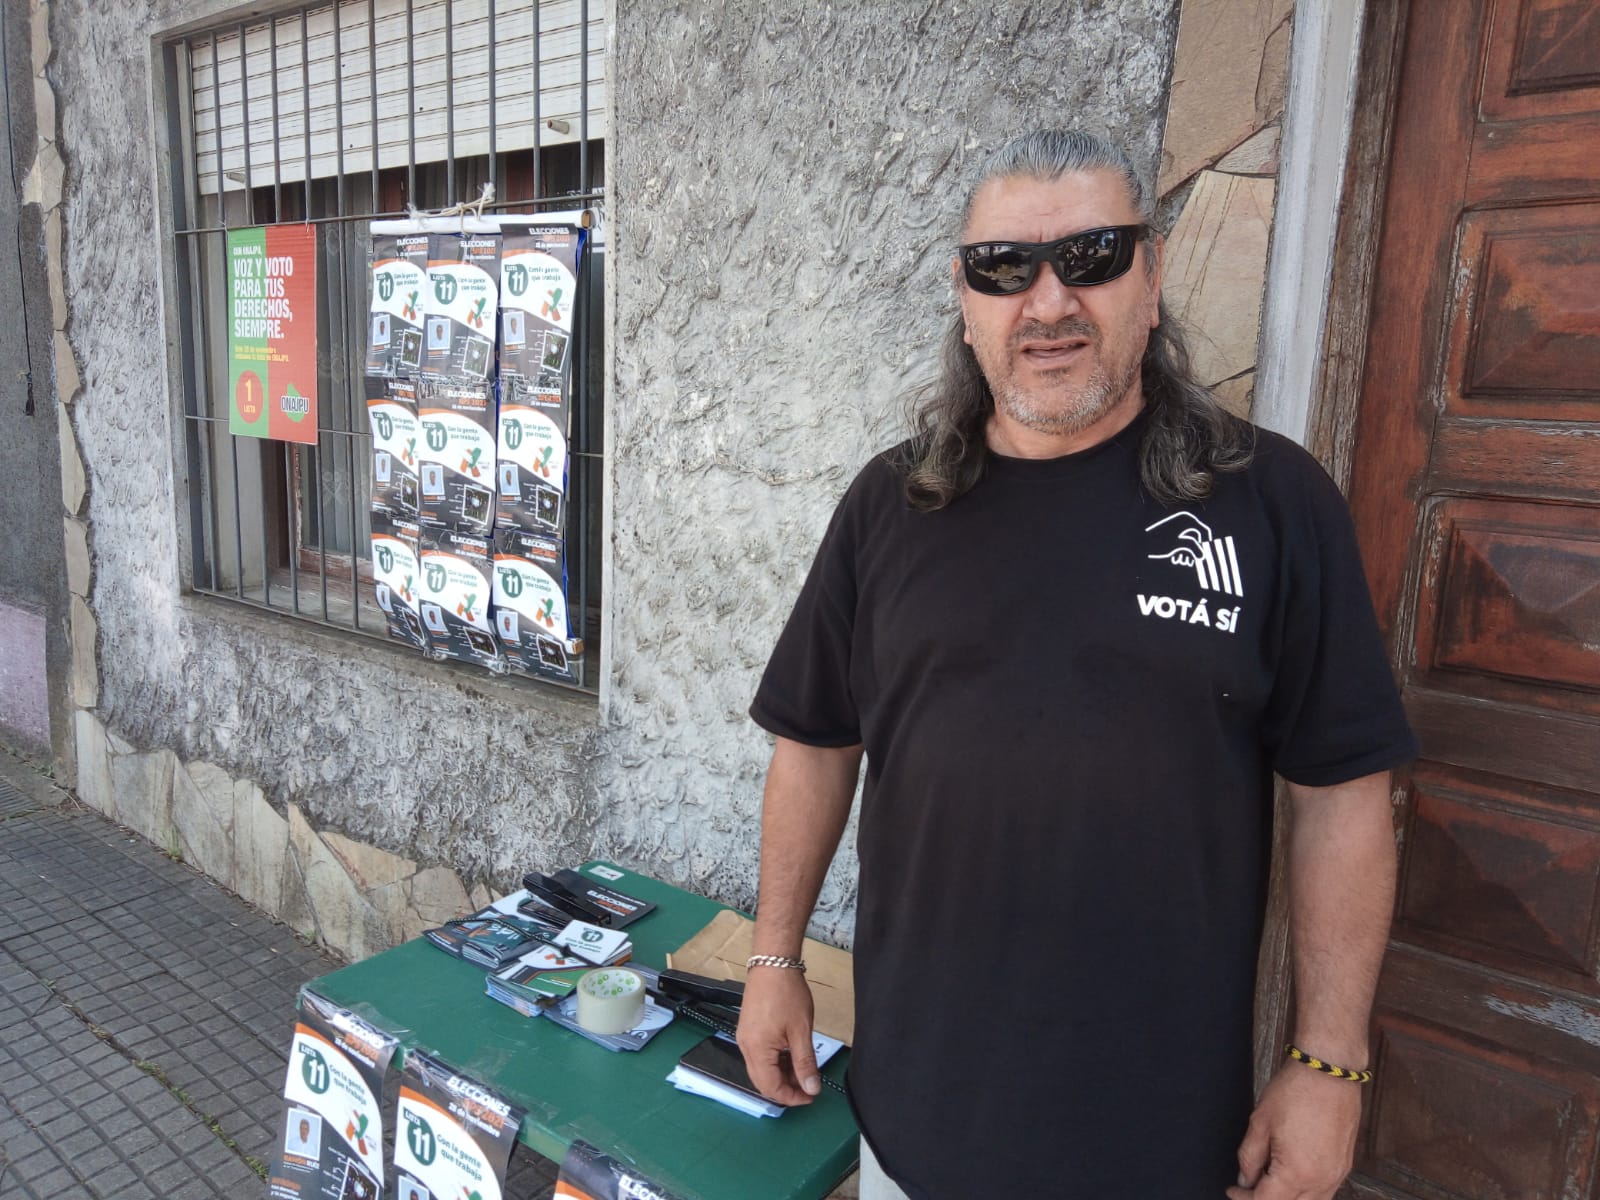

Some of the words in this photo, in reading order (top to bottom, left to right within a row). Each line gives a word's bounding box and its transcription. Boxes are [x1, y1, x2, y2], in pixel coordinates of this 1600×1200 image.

[234, 258, 253, 278] VOZ
[255, 258, 262, 277] Y
[264, 256, 294, 277] VOTO
[234, 278, 262, 298] PARA
[264, 278, 284, 298] TUS
[382, 279, 392, 298] 11
[440, 282, 452, 301] 11
[512, 272, 524, 292] 11
[234, 298, 292, 322] DERECHOS,
[234, 319, 284, 338] SIEMPRE.
[245, 379, 252, 402] 1
[448, 390, 486, 399] ELECCIONES
[281, 396, 309, 414] ONAJPU
[380, 418, 390, 438] 11
[508, 426, 519, 446] 11
[430, 429, 443, 448] 11
[382, 552, 391, 570] 11
[432, 570, 443, 590] 11
[506, 575, 520, 595] 11
[1136, 594, 1211, 627] VOTÁ
[1215, 606, 1241, 634] SÍ
[309, 1059, 325, 1090] 11
[329, 1064, 341, 1076] Con
[342, 1071, 348, 1081] la
[334, 1077, 344, 1088] que
[447, 1076, 511, 1117] ELECCIONES
[413, 1128, 430, 1160] 11
[437, 1134, 451, 1148] Con
[451, 1142, 459, 1153] la
[459, 1148, 481, 1168] gente
[441, 1149, 454, 1163] que
[455, 1158, 482, 1182] trabaja
